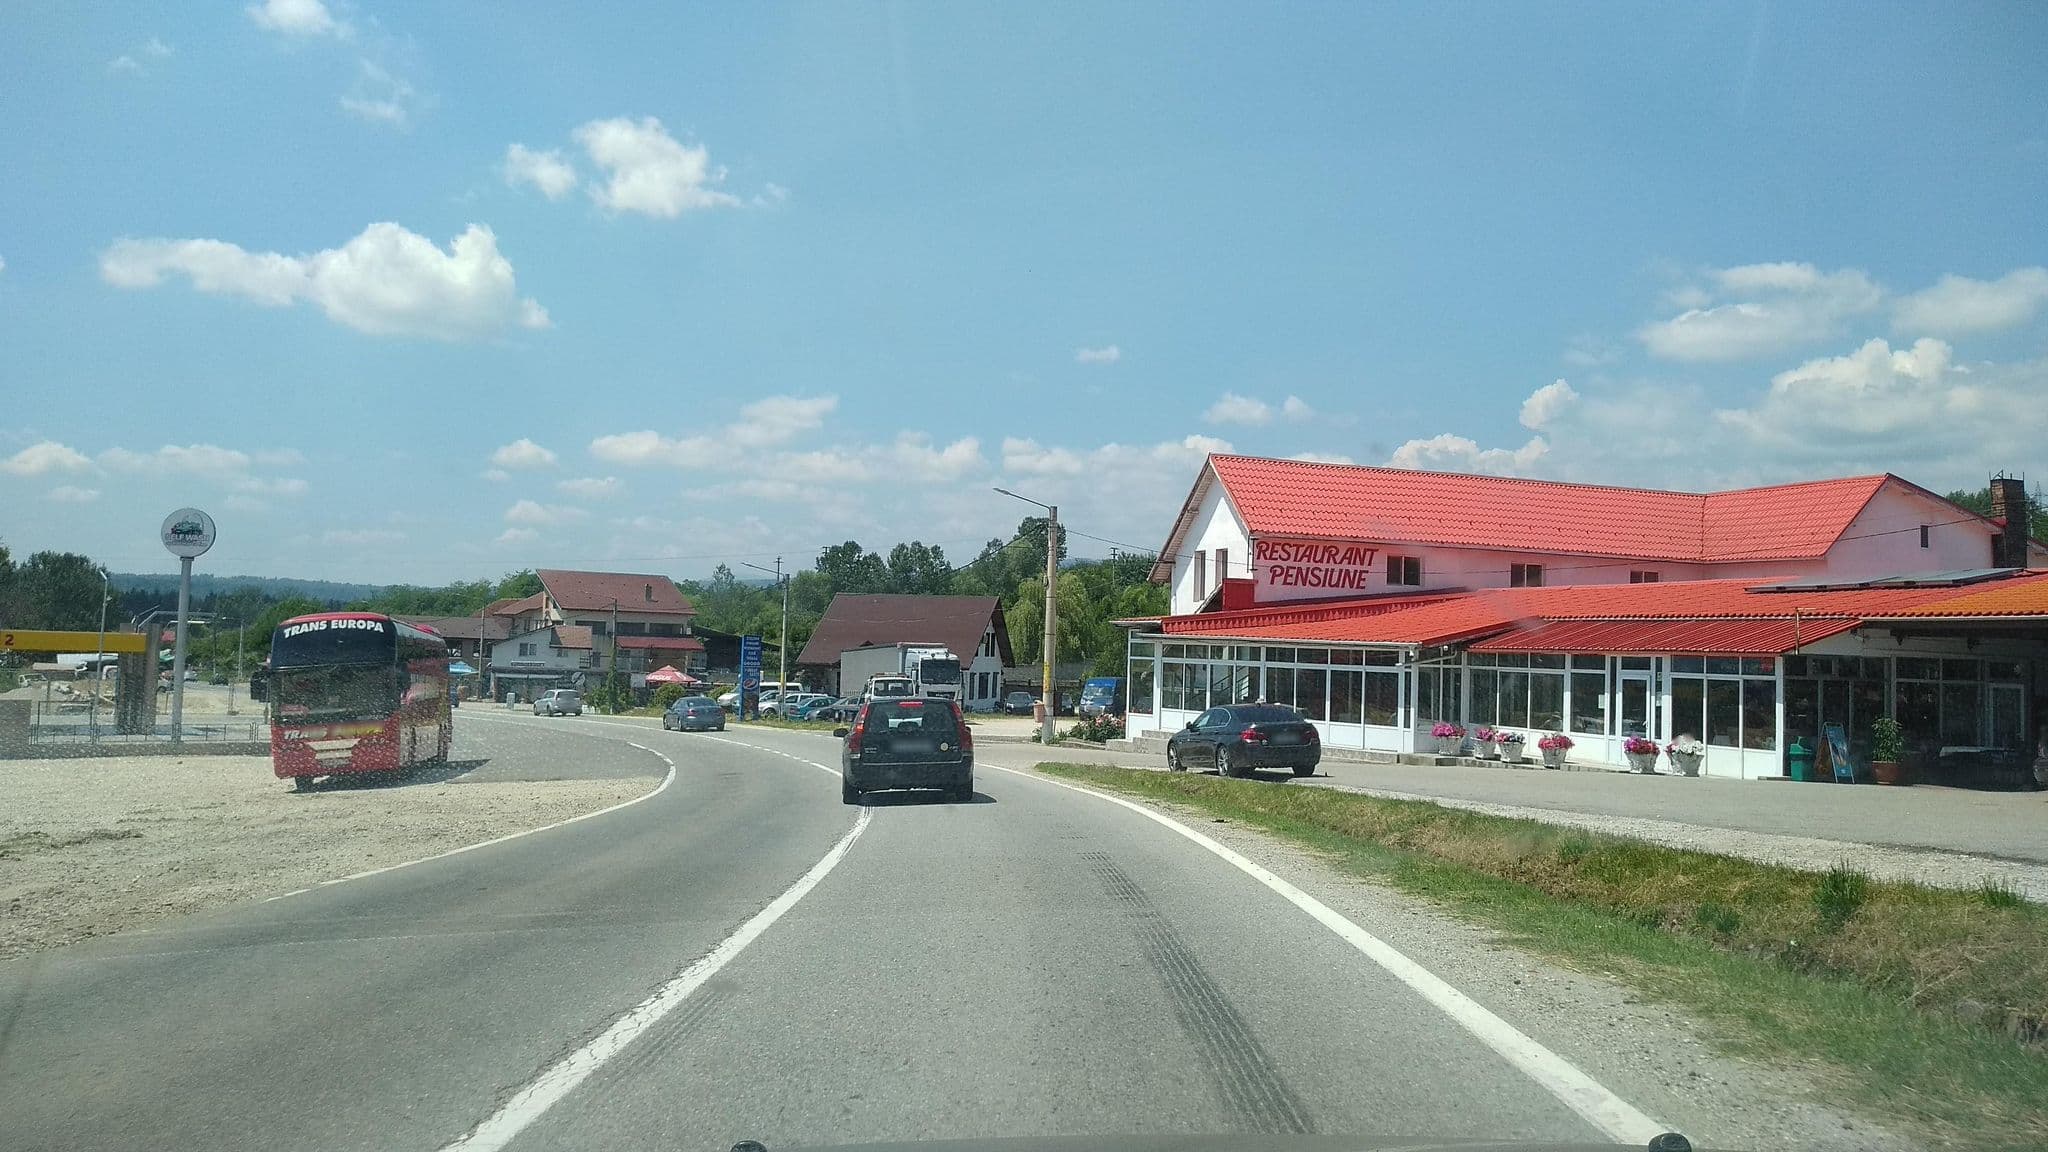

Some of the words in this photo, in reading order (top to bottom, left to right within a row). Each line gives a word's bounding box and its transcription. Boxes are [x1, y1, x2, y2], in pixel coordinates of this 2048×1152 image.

[1256, 540, 1379, 567] RESTAURANT
[1269, 564, 1369, 589] PENSIUNE
[283, 620, 327, 638] TRANS
[330, 619, 384, 633] EUROPA
[4, 634, 14, 646] 2
